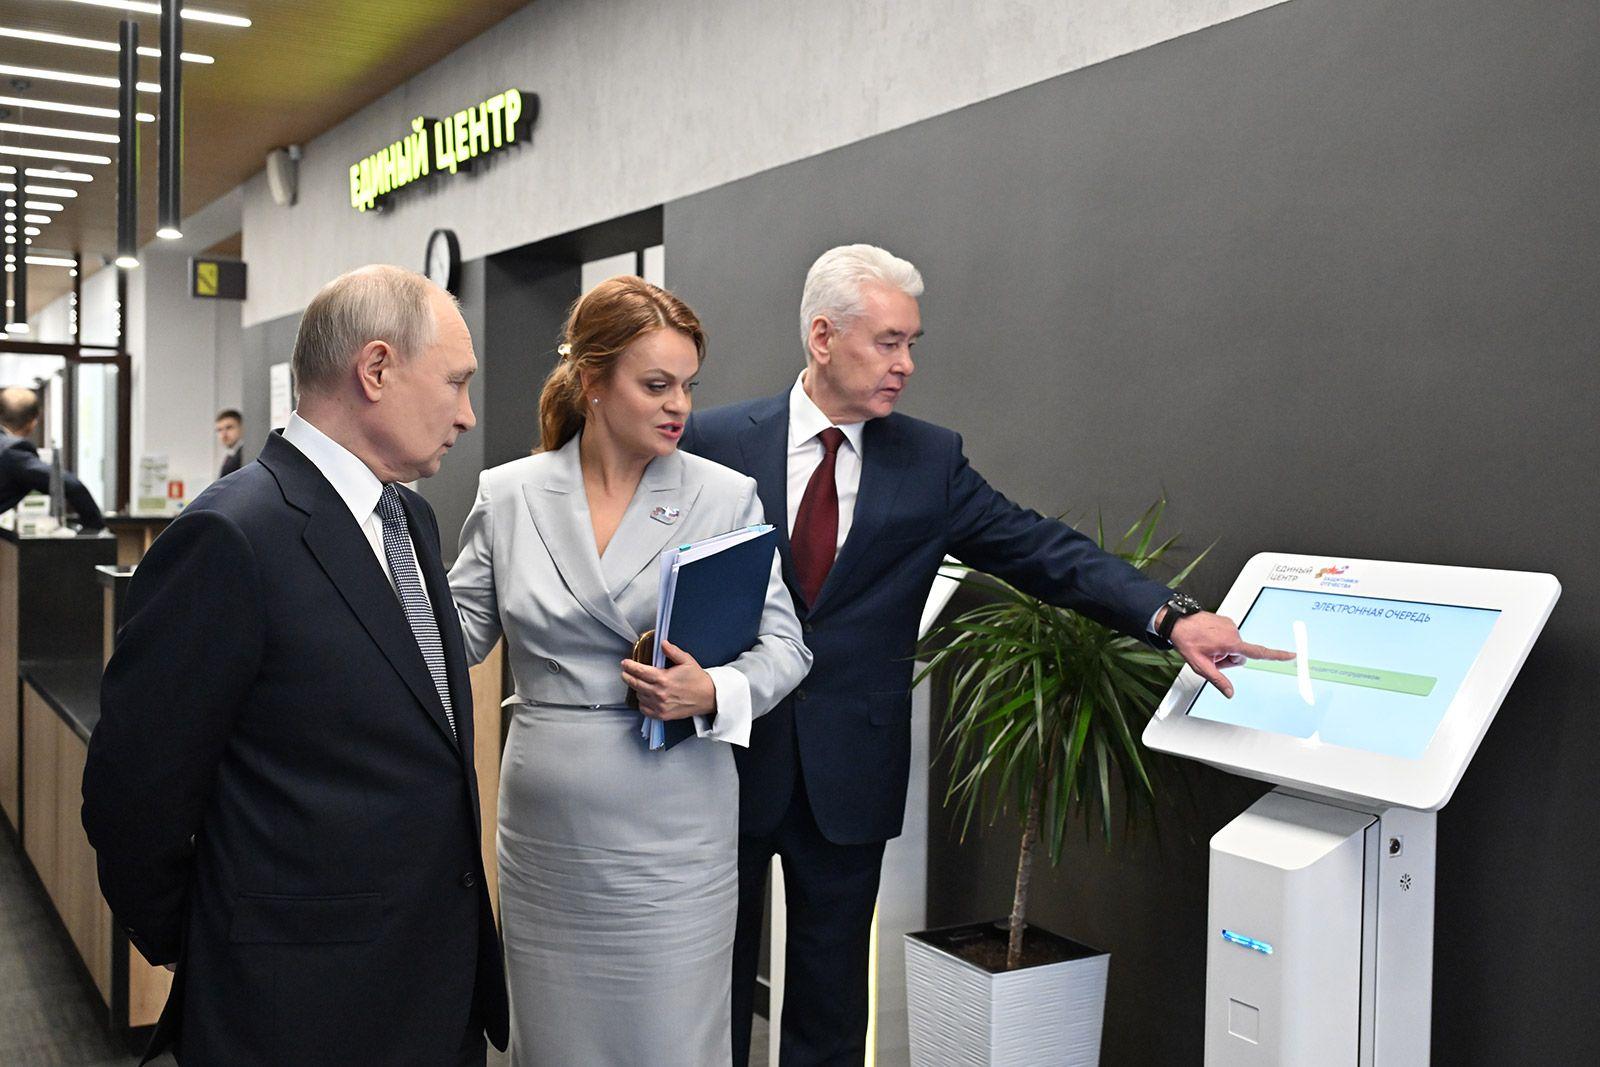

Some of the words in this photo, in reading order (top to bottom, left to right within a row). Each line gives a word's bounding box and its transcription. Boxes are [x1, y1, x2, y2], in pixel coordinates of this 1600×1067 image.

[349, 116, 429, 213] ЕДИНЫЙ
[433, 88, 522, 175] ЦЕНТР
[1270, 573, 1298, 581] ЦЕНТР
[1275, 564, 1313, 575] ЕДИНЫЙ
[1311, 601, 1384, 618] ЭЛЕКТРОННАЯ
[1384, 609, 1431, 623] ОЧЕРЕДЬ
